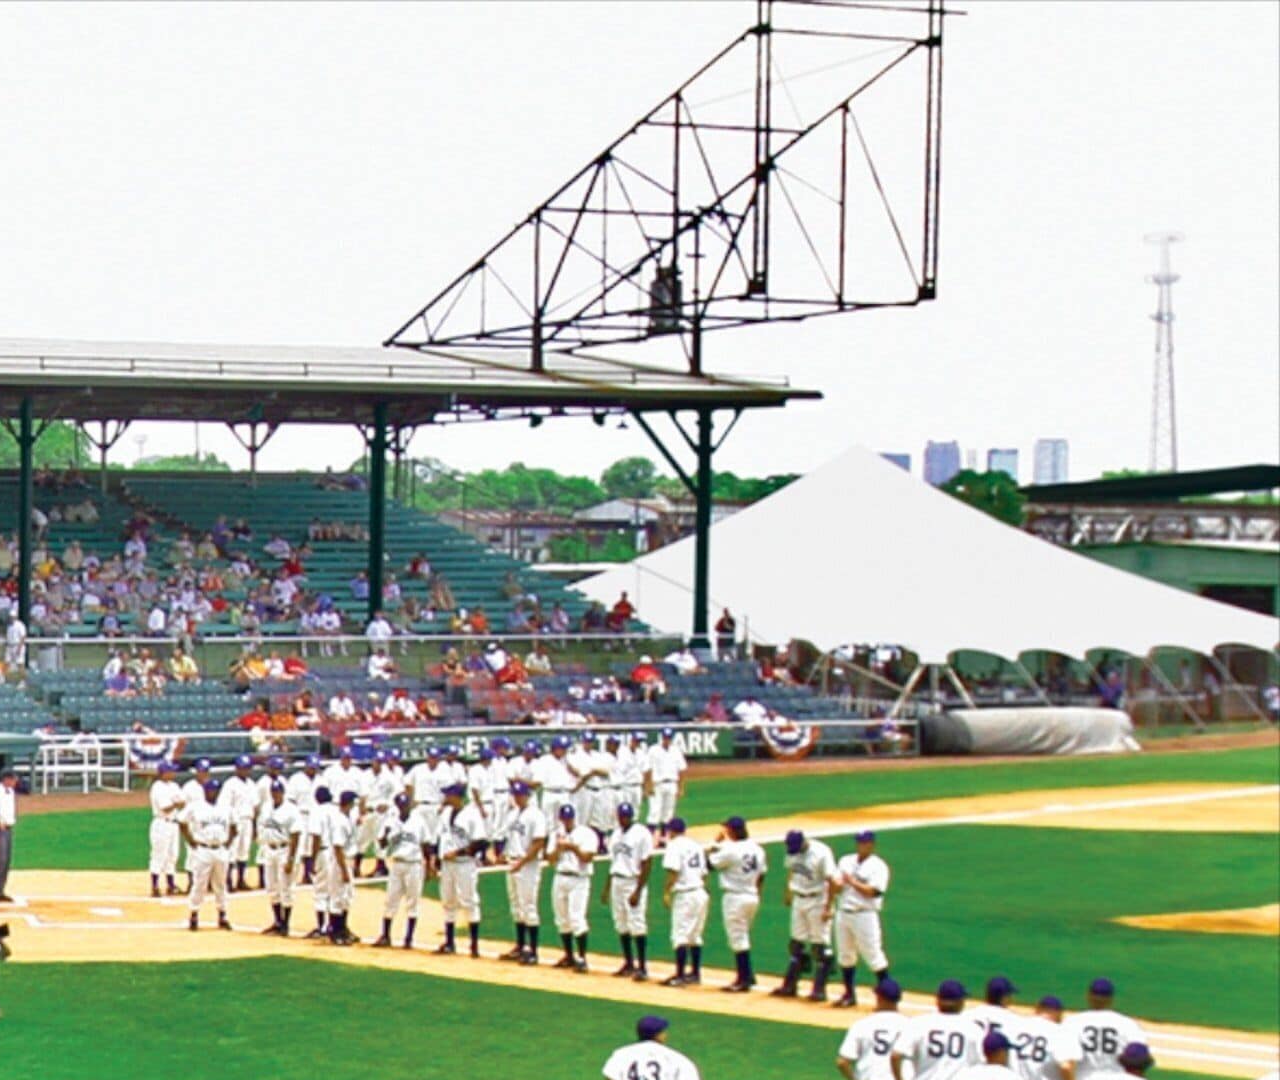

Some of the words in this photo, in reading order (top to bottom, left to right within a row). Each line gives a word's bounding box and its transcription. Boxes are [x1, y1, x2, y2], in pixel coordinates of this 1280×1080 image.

[658, 731, 719, 755] ARK
[928, 1030, 965, 1058] 50
[1017, 1033, 1048, 1062] 28
[1082, 1025, 1119, 1053] 36
